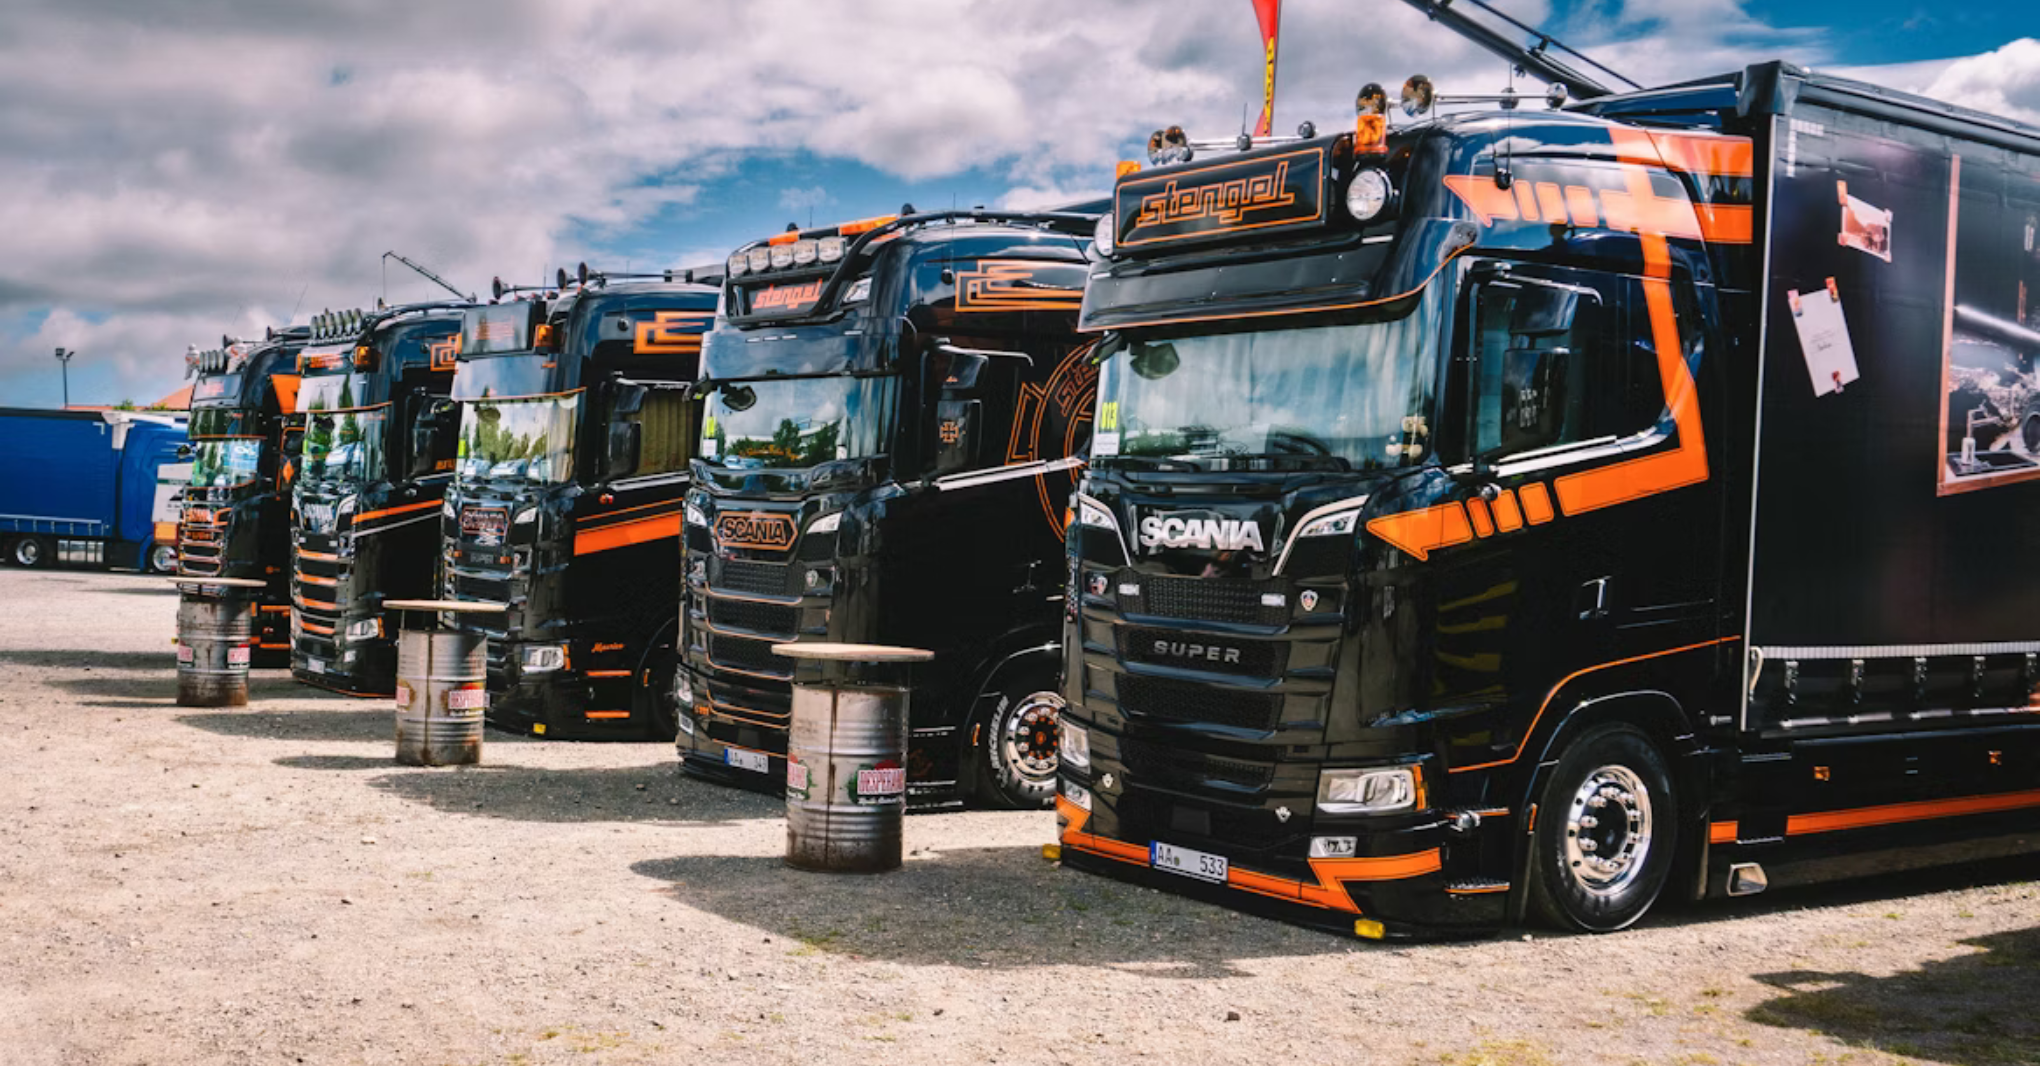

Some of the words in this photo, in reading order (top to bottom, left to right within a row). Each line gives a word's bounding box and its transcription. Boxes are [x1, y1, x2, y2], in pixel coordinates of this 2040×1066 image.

[1136, 161, 1295, 229] stengel
[752, 278, 823, 309] stengel
[724, 518, 786, 544] SCANIA
[1140, 515, 1264, 552] SCANIA
[1154, 640, 1241, 664] SUPER
[989, 695, 1009, 769] MICHELIN
[1157, 845, 1173, 865] AA
[1200, 855, 1224, 876] 533
